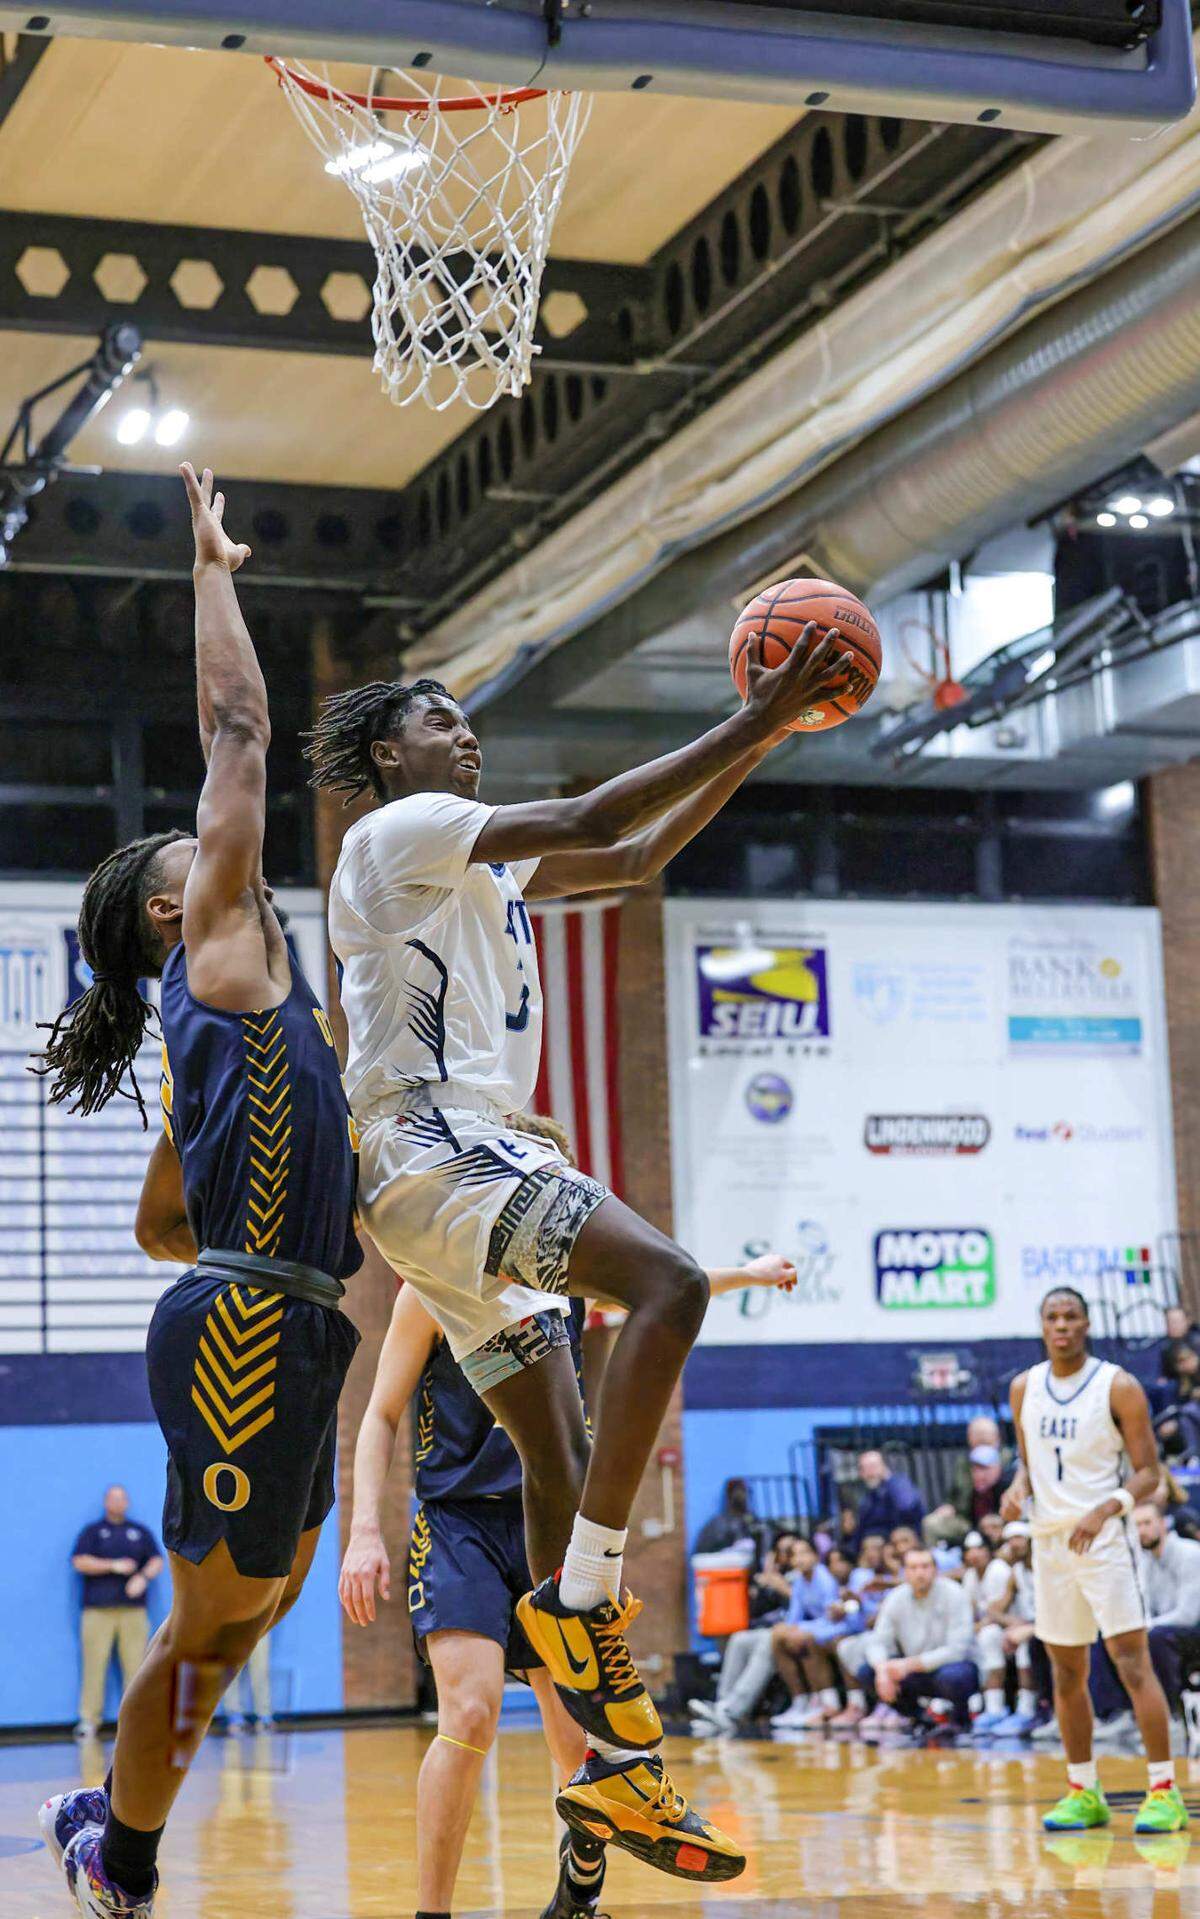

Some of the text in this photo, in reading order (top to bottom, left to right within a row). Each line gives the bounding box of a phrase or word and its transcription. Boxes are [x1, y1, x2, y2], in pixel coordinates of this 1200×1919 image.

[709, 1002, 819, 1036] SEIU
[880, 1232, 988, 1266] MOTO
[881, 1270, 988, 1304] MART
[1039, 1415, 1078, 1439] EAST
[1054, 1446, 1063, 1482] 1
[202, 1461, 251, 1513] O
